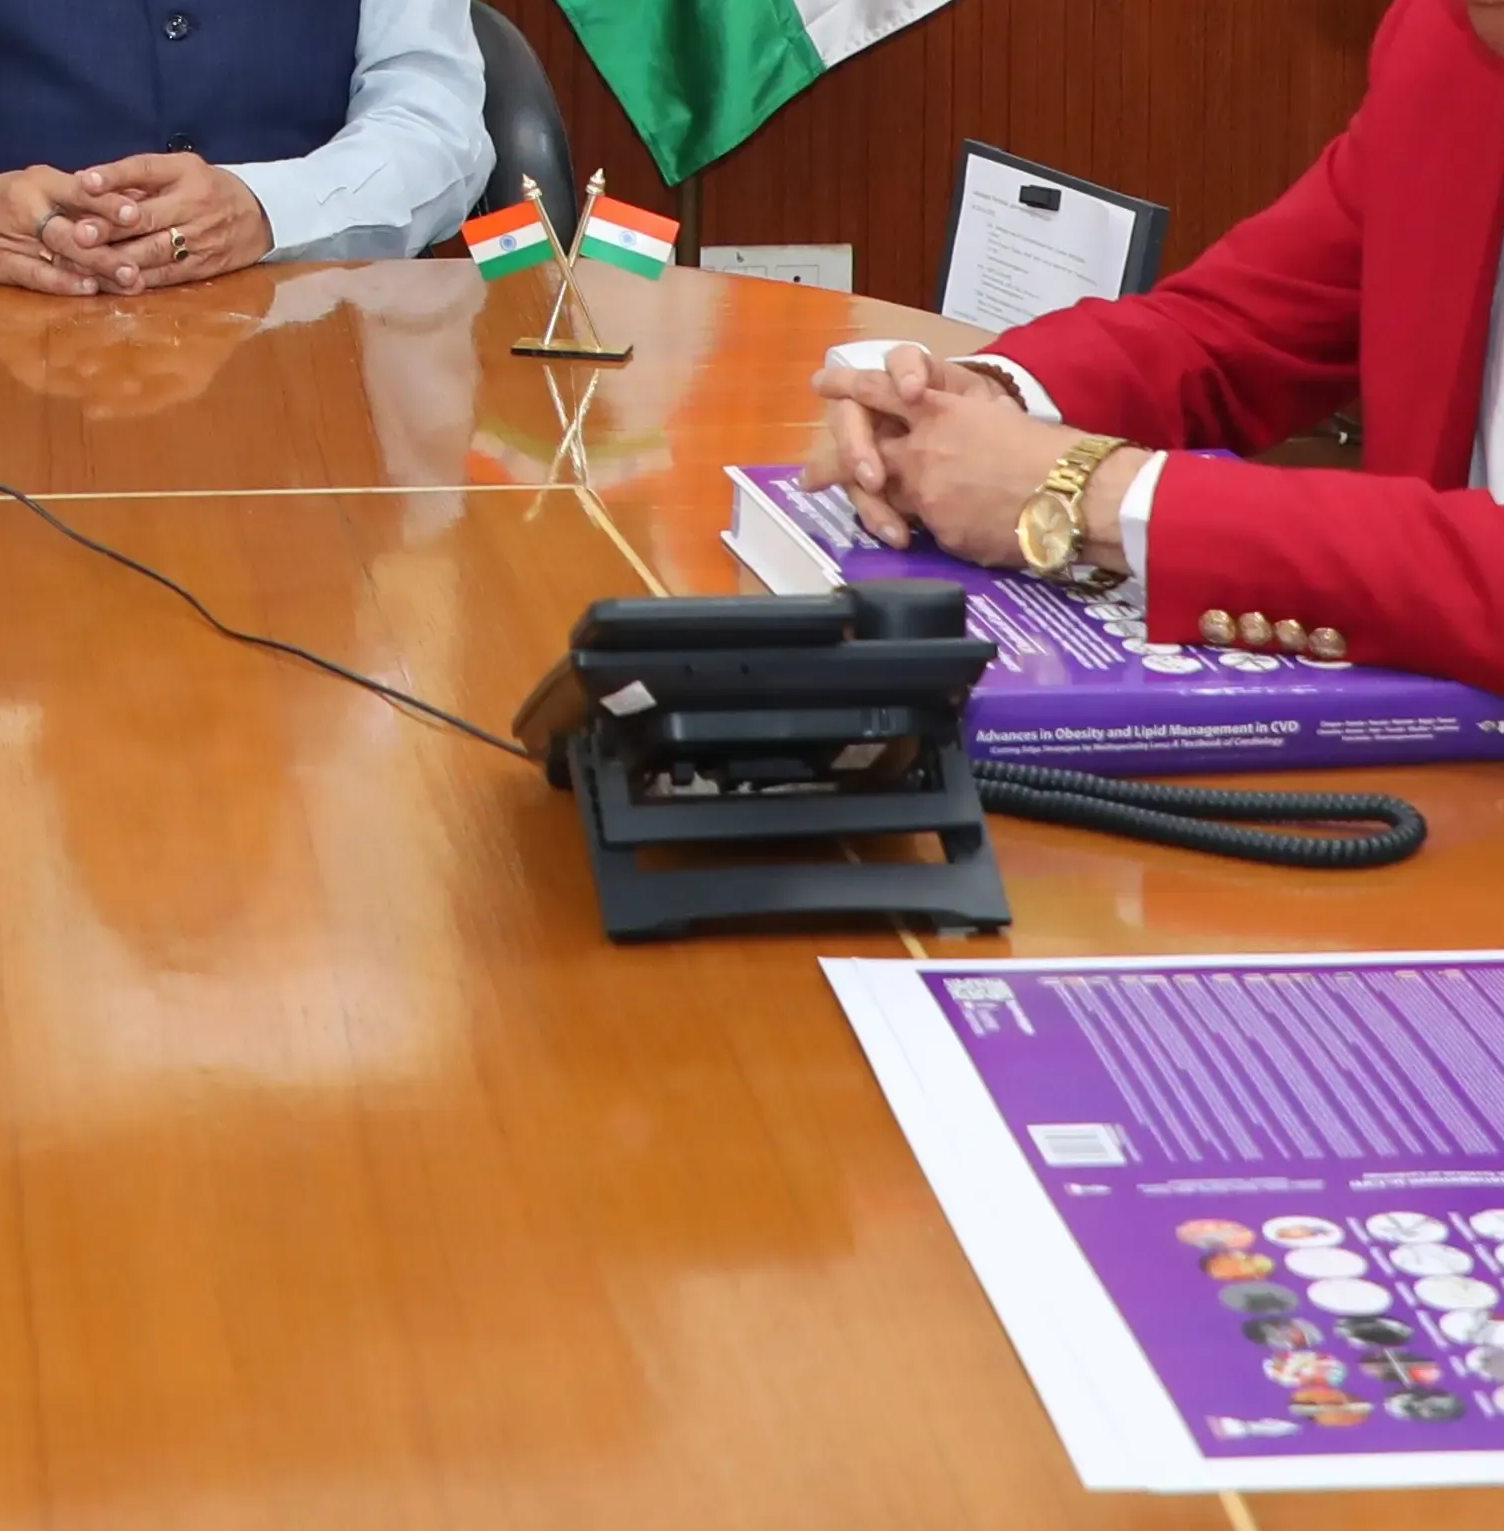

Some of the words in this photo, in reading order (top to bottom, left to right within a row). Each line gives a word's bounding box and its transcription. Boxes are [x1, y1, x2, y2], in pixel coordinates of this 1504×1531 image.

[976, 730, 1038, 742] Advances
[1040, 728, 1052, 740] in
[1055, 727, 1104, 741] Obesity
[1107, 726, 1131, 738] and
[1134, 724, 1165, 739] Lipid
[1169, 723, 1253, 737] Management
[1255, 721, 1268, 733] in
[1271, 720, 1300, 732] CVD
